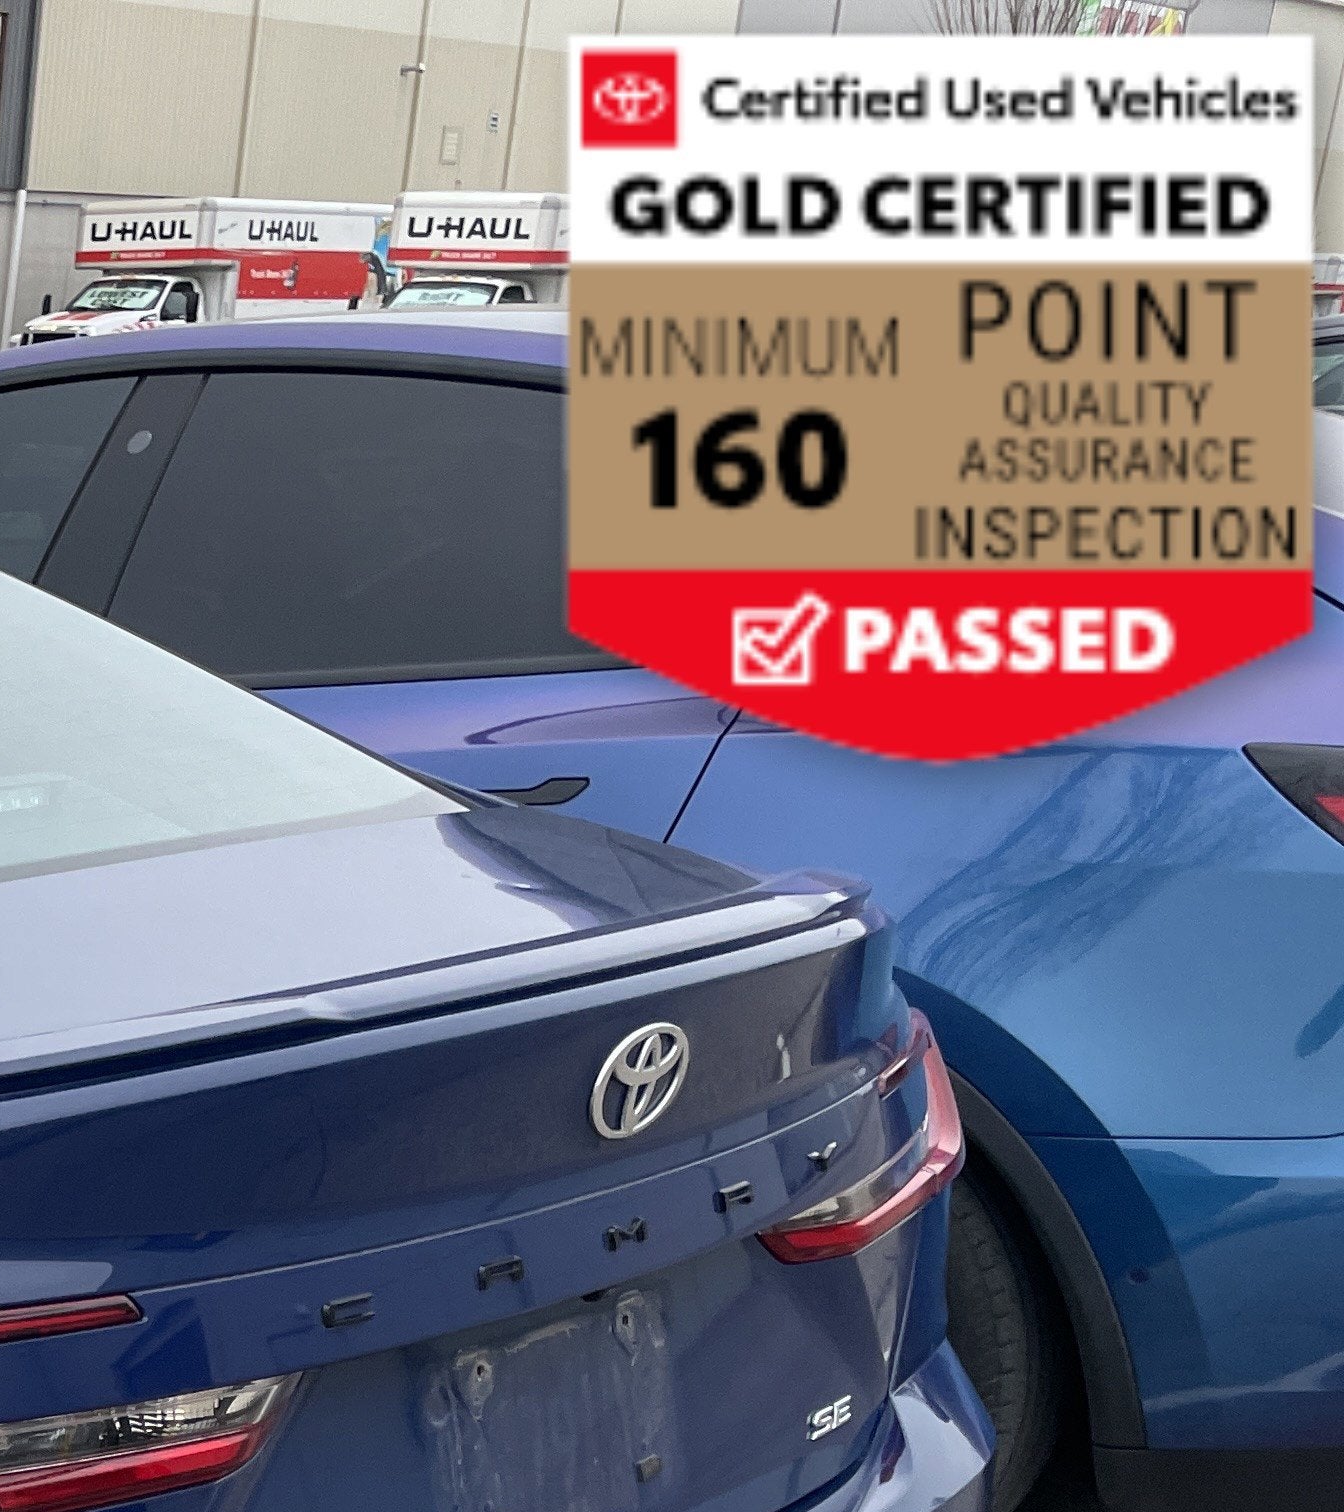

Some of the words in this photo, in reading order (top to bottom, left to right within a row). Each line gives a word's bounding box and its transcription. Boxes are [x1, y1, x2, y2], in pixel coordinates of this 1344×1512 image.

[91, 219, 193, 242] U-HAUL
[248, 219, 319, 242] U-HAUL
[408, 216, 530, 240] U-HAUL
[807, 1394, 853, 1441] SE
